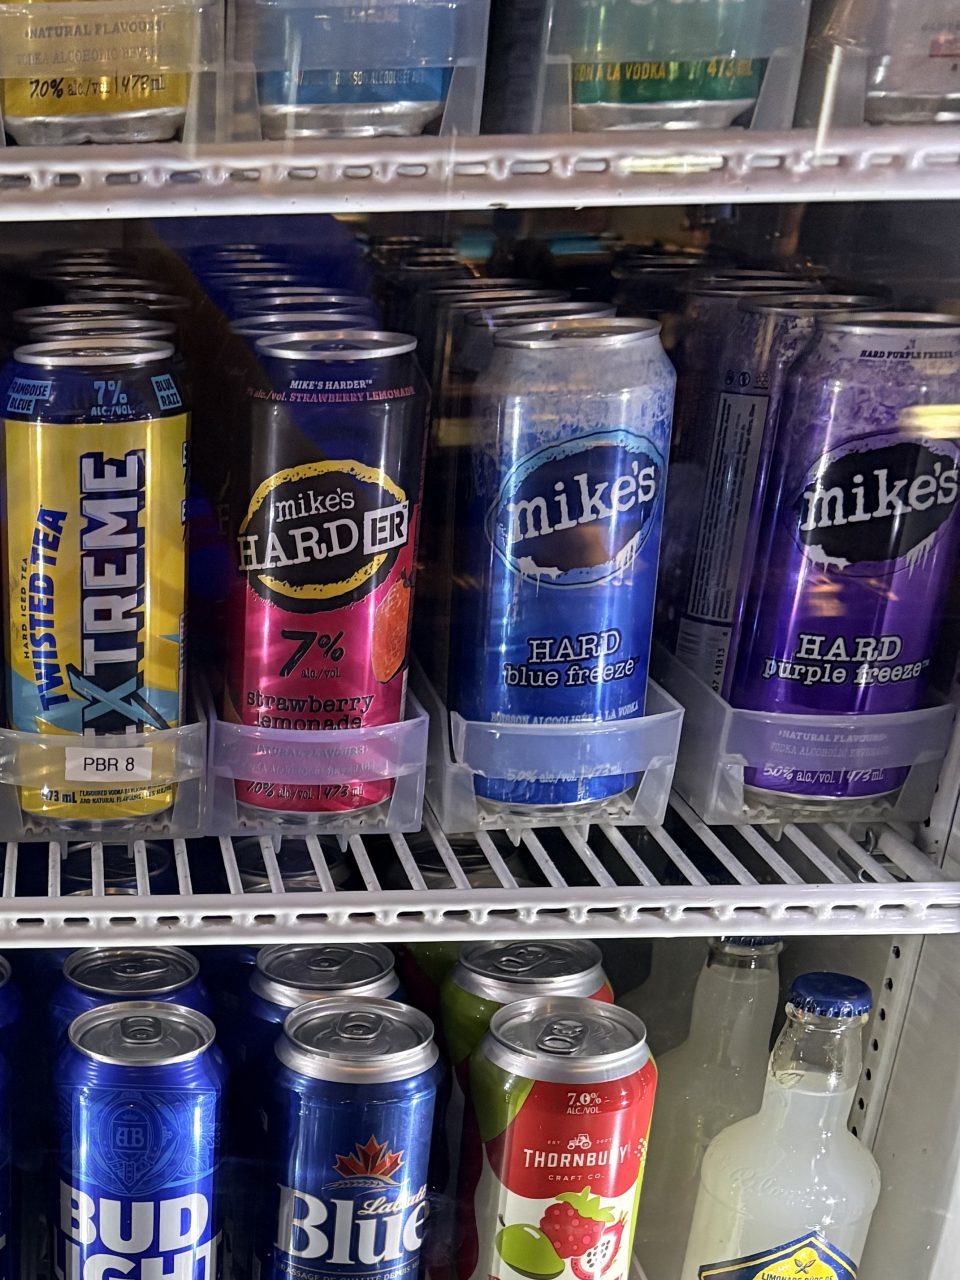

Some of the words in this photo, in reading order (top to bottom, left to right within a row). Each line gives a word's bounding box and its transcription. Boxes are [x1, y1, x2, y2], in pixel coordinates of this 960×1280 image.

[93, 380, 128, 405] 7%
[154, 377, 173, 392] BLUE
[9, 397, 33, 412] BLEUE
[276, 488, 355, 523] mike's
[506, 460, 656, 545] mike's
[800, 461, 960, 532] mike's
[31, 505, 68, 567] TEA
[237, 506, 408, 571] HARDER
[29, 573, 70, 712] TWISTED
[279, 629, 345, 678] 7%
[528, 629, 622, 664] HARD
[795, 633, 904, 663] HARD
[504, 663, 559, 687] blue
[565, 658, 636, 687] freeze
[762, 657, 847, 686] purple
[853, 661, 922, 687] freeze
[247, 690, 375, 715] strawberry
[256, 710, 363, 731] lemonade
[83, 757, 119, 772] PBR
[125, 757, 135, 771] 8
[567, 1091, 602, 1107] 7.0%
[523, 1144, 628, 1169] THORNBUY
[548, 1173, 582, 1182] CRAFT
[358, 1183, 429, 1216] Labatt
[59, 1180, 210, 1255] BUD
[273, 1182, 432, 1266] Blue
